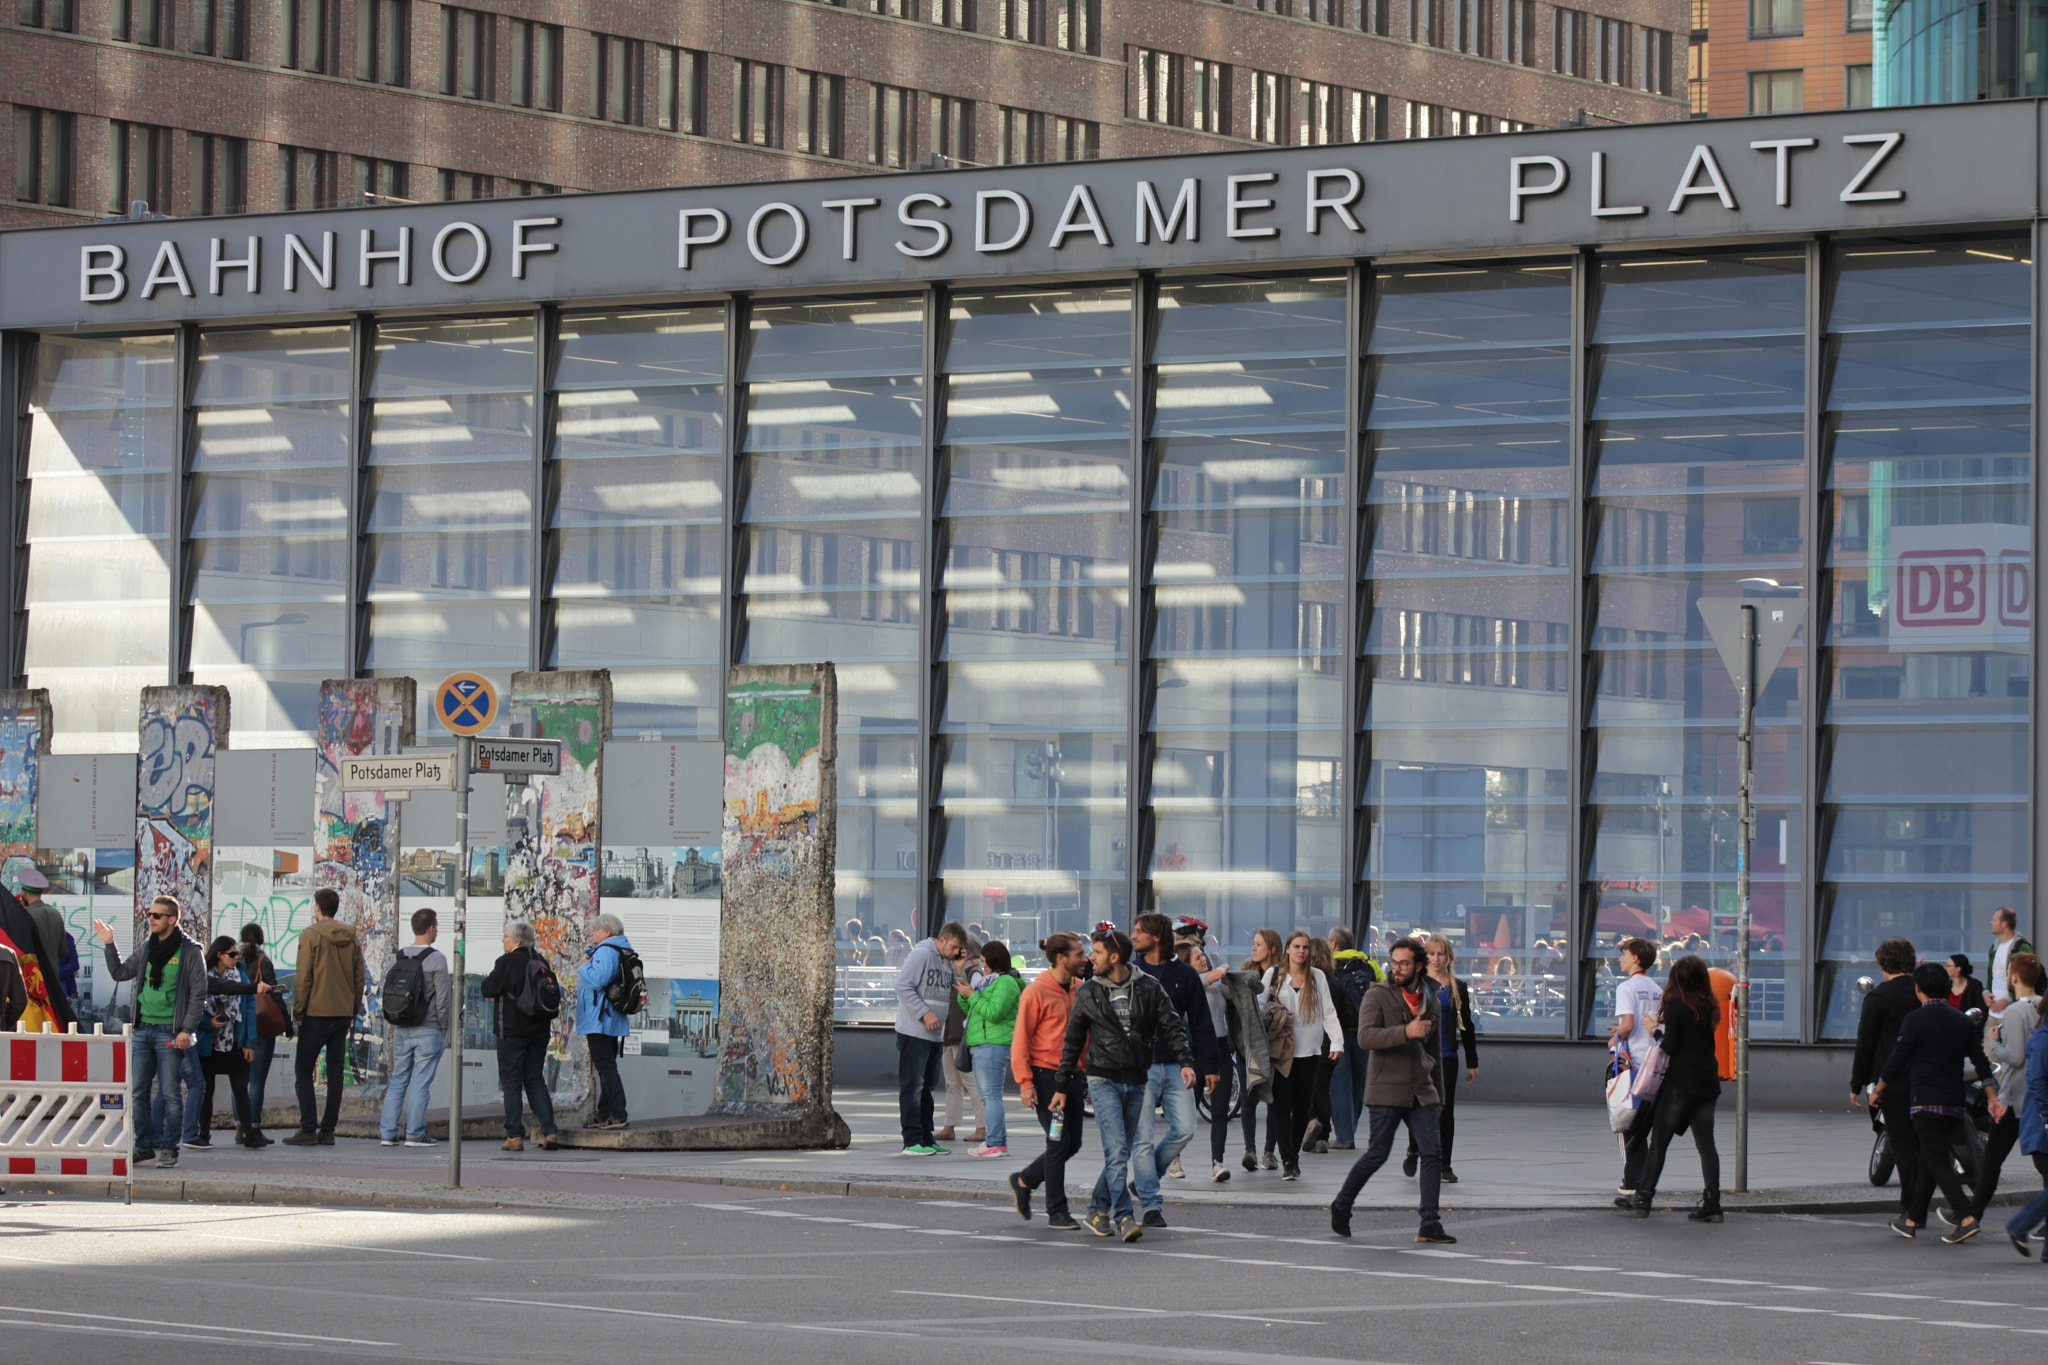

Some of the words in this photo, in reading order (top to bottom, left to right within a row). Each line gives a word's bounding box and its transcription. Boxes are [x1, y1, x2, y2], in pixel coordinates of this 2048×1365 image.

[80, 216, 561, 302] BAHNHOF
[678, 168, 1366, 270] POTSDAMER
[1509, 132, 1906, 222] PLATZ
[1908, 562, 1976, 613] DB
[351, 763, 413, 780] Potsdamer
[416, 762, 442, 781] Platz
[479, 745, 530, 763] Potsdamer
[533, 747, 554, 767] Platz
